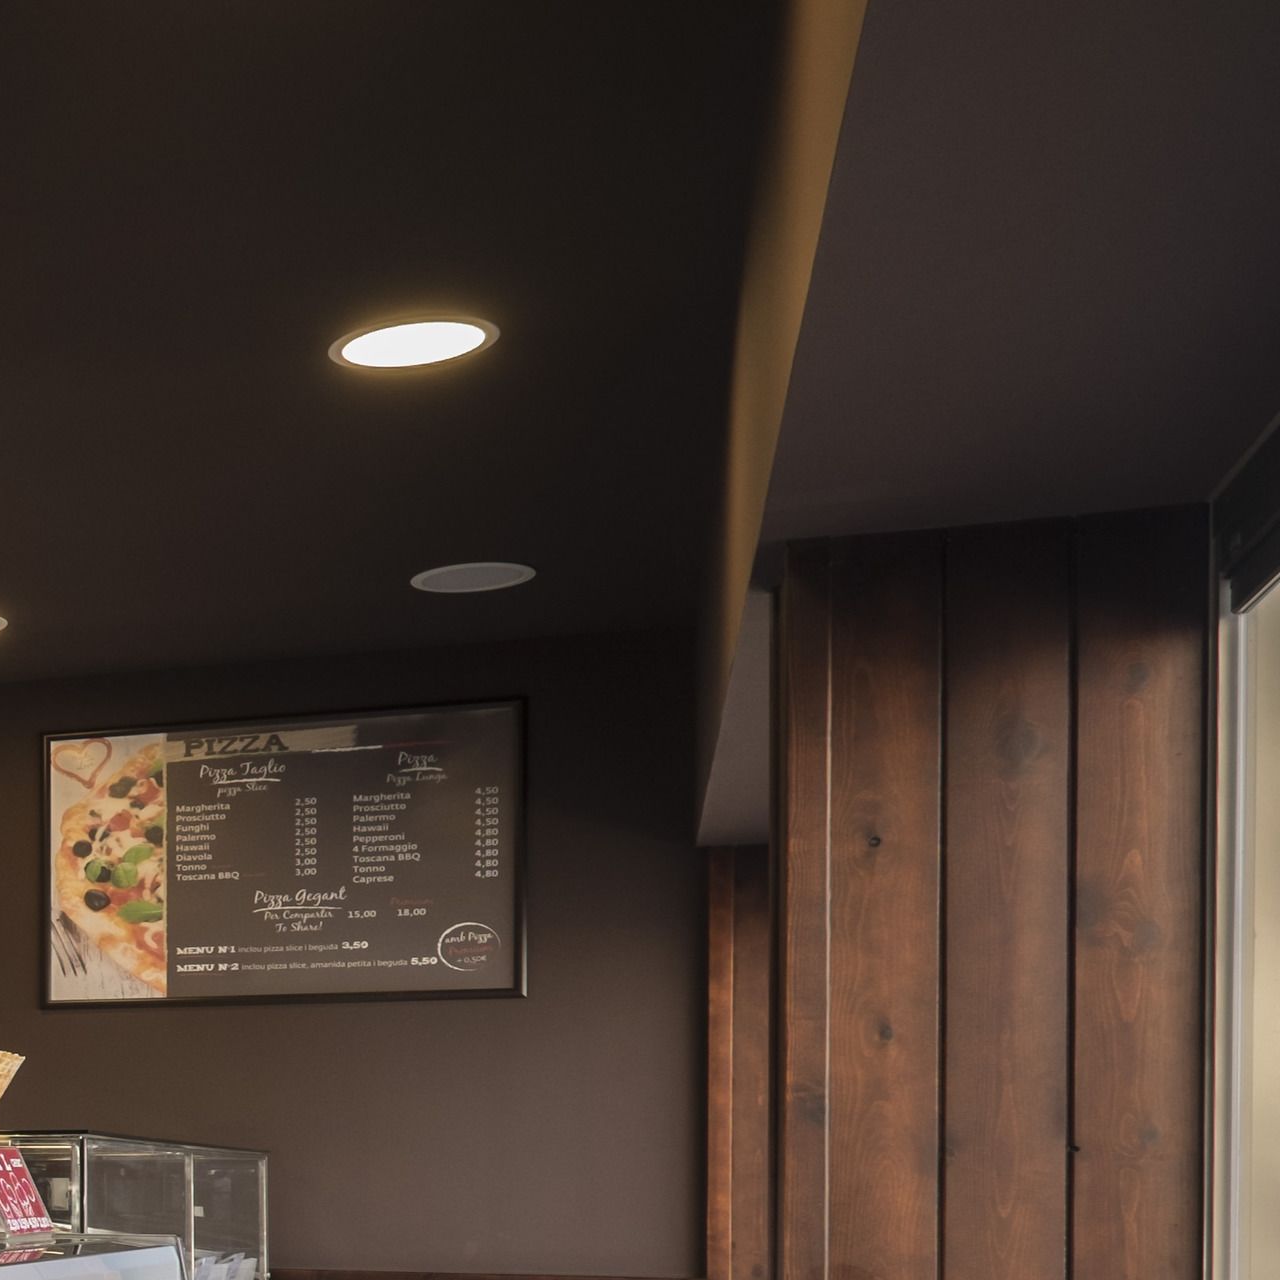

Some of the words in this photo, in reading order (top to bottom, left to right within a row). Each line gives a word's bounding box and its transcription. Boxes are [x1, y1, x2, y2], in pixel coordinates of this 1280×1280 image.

[183, 731, 288, 758] PIZZA
[397, 751, 435, 768] Pizza
[199, 764, 236, 782] Pizza
[239, 758, 284, 779] Taglio
[295, 797, 316, 805] 2,50
[353, 792, 410, 802] Margherita
[175, 803, 229, 812] Margherita
[353, 803, 405, 811] Prosciutto
[175, 813, 225, 821] Prosciutto
[175, 823, 209, 832] Funghi
[295, 827, 316, 835] 2,50
[352, 834, 404, 843] Pepperoni
[361, 843, 417, 852] Formaggio
[176, 853, 212, 861] Diavola
[295, 857, 316, 865] 3,00
[352, 875, 393, 884] Caprese
[254, 890, 292, 908] Pizza
[348, 910, 376, 918] 15,00
[398, 908, 426, 916] 18,00
[175, 945, 214, 955] MENU
[341, 940, 368, 950] 3,50
[176, 963, 214, 972] MENU
[410, 955, 438, 966] 5,50
